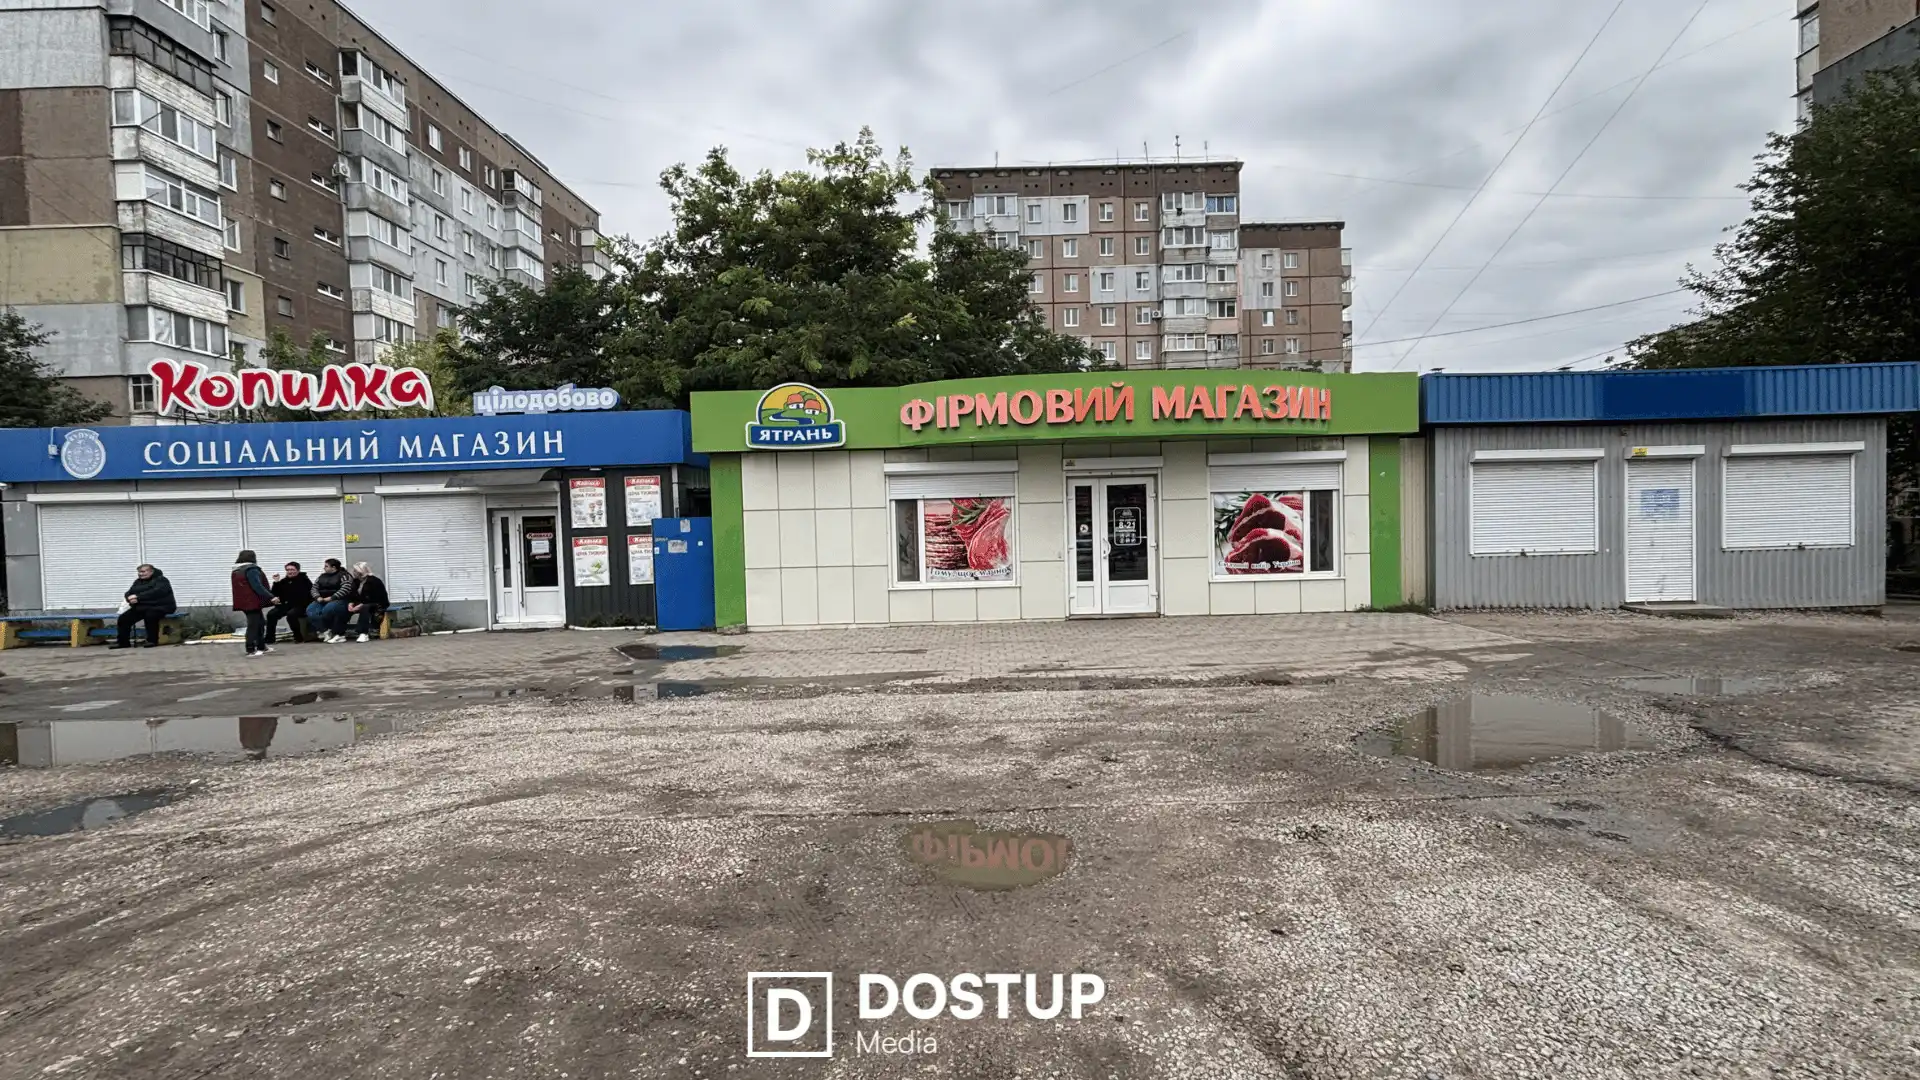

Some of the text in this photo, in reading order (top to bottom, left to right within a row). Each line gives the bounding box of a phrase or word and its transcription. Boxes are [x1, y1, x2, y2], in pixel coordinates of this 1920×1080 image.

[149, 359, 434, 415] Копилка
[476, 388, 615, 413] цілодобово
[899, 381, 1332, 431] ФІРМОВИЙ МАГАЗИН
[143, 429, 563, 466] СОЦІАЛЬНИЙ МАГАЗИН
[759, 428, 833, 442] ЯТРАНЬ
